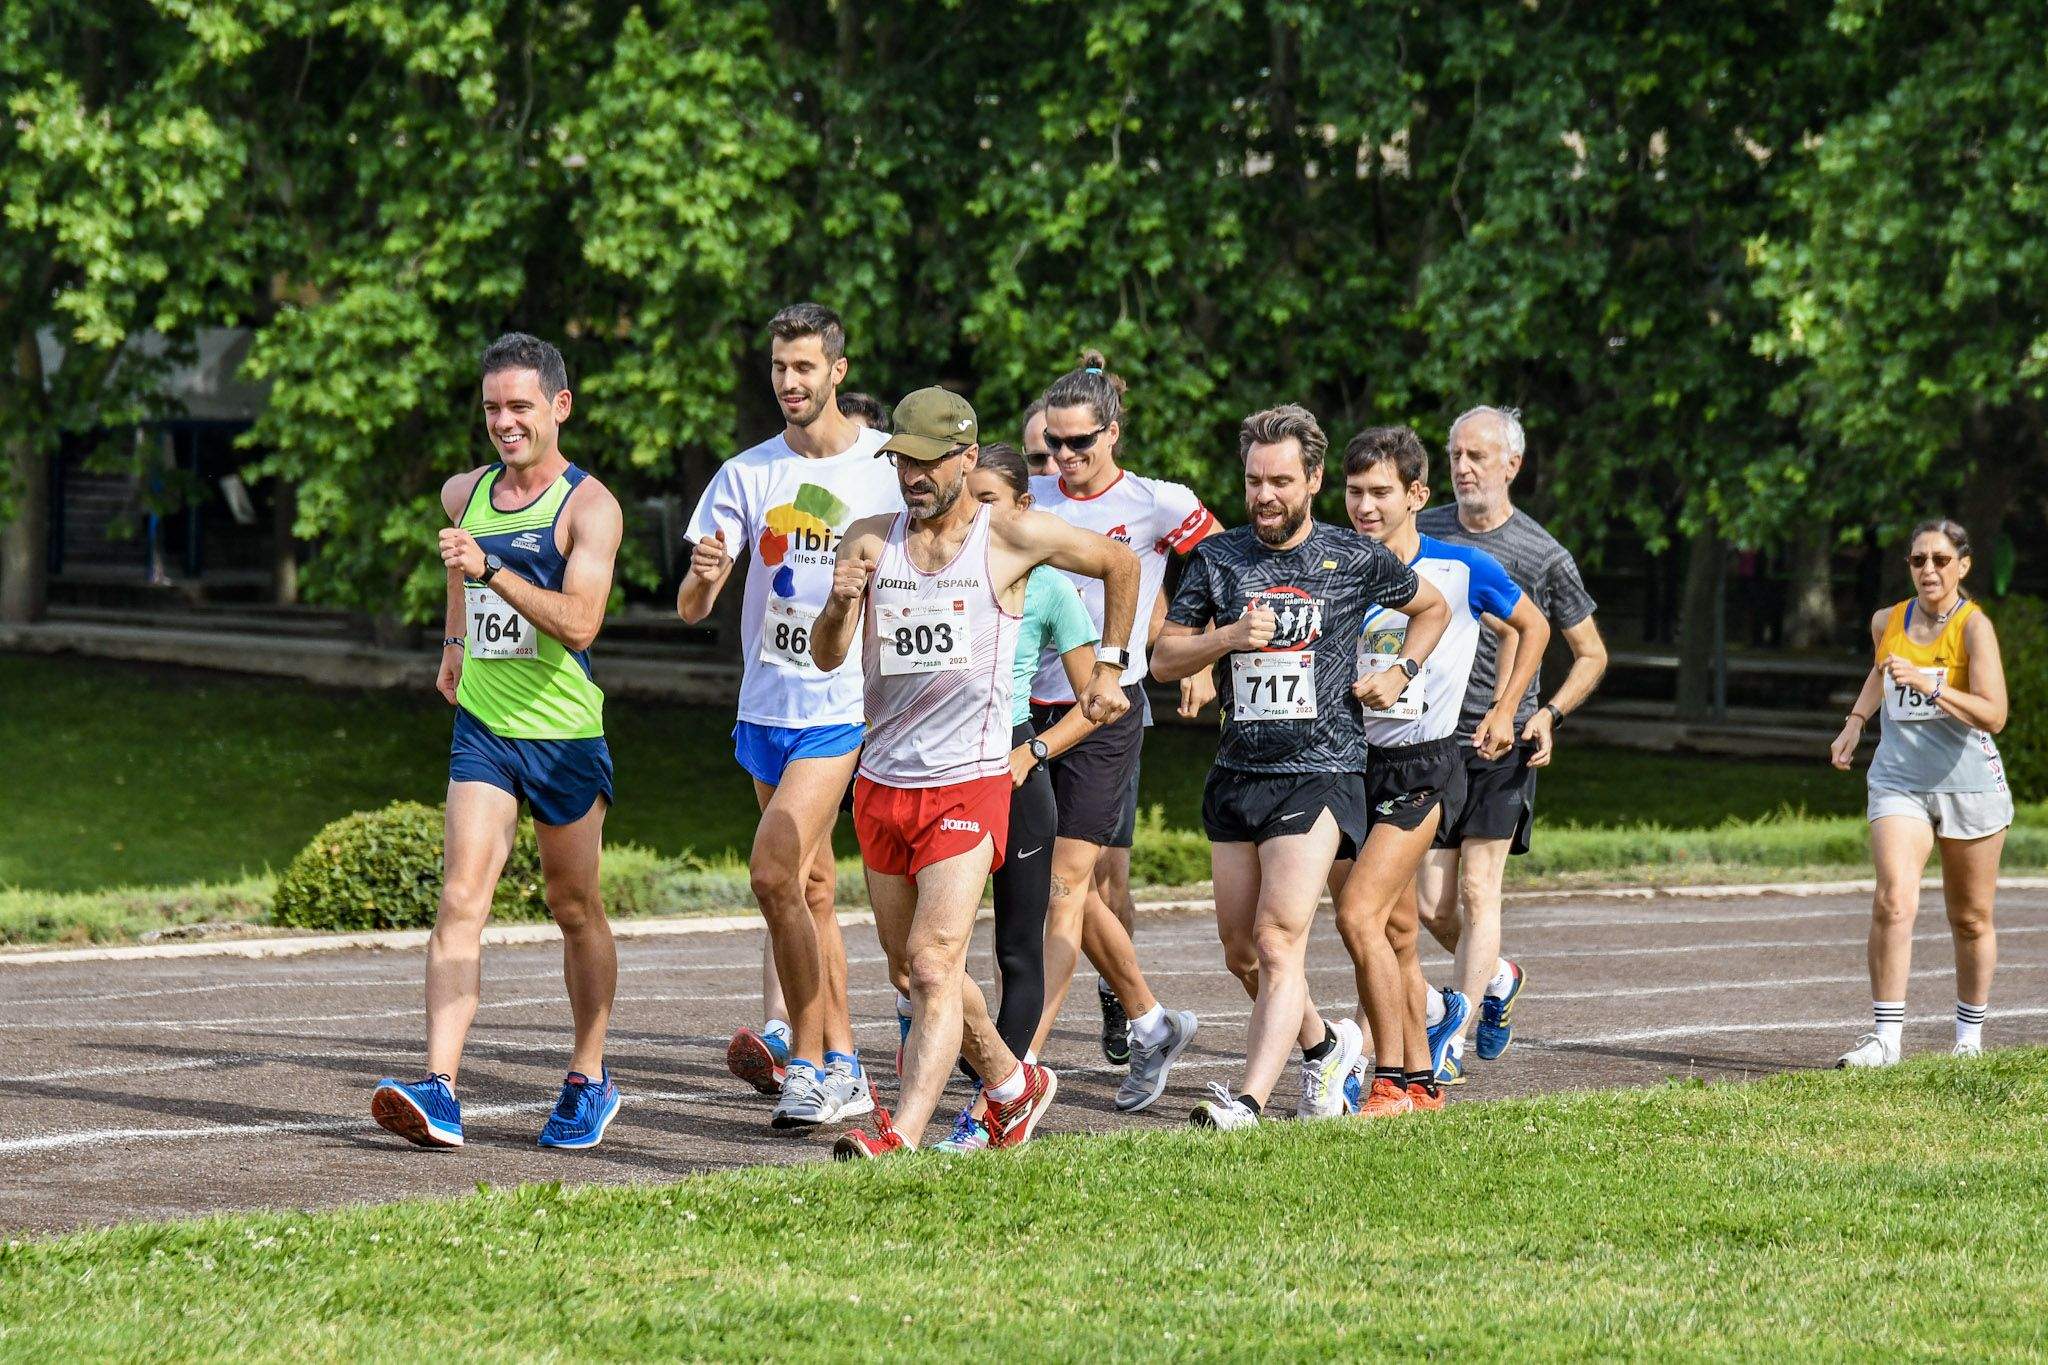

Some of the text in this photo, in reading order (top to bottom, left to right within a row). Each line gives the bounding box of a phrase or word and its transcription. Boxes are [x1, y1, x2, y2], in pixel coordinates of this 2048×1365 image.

[794, 554, 834, 565] Illes Ba
[877, 577, 917, 591] Joma
[936, 577, 979, 589] ESPAÑA
[1245, 591, 1294, 600] SOSPECHOSOS
[1284, 598, 1325, 606] HABITUALES
[474, 613, 521, 642] 764
[775, 623, 812, 655] 86
[895, 622, 953, 656] 803
[515, 647, 533, 655] 2023
[949, 656, 968, 665] 2023
[1246, 675, 1300, 703] 717
[1296, 706, 1313, 714] 2023
[940, 818, 980, 833] Joma
